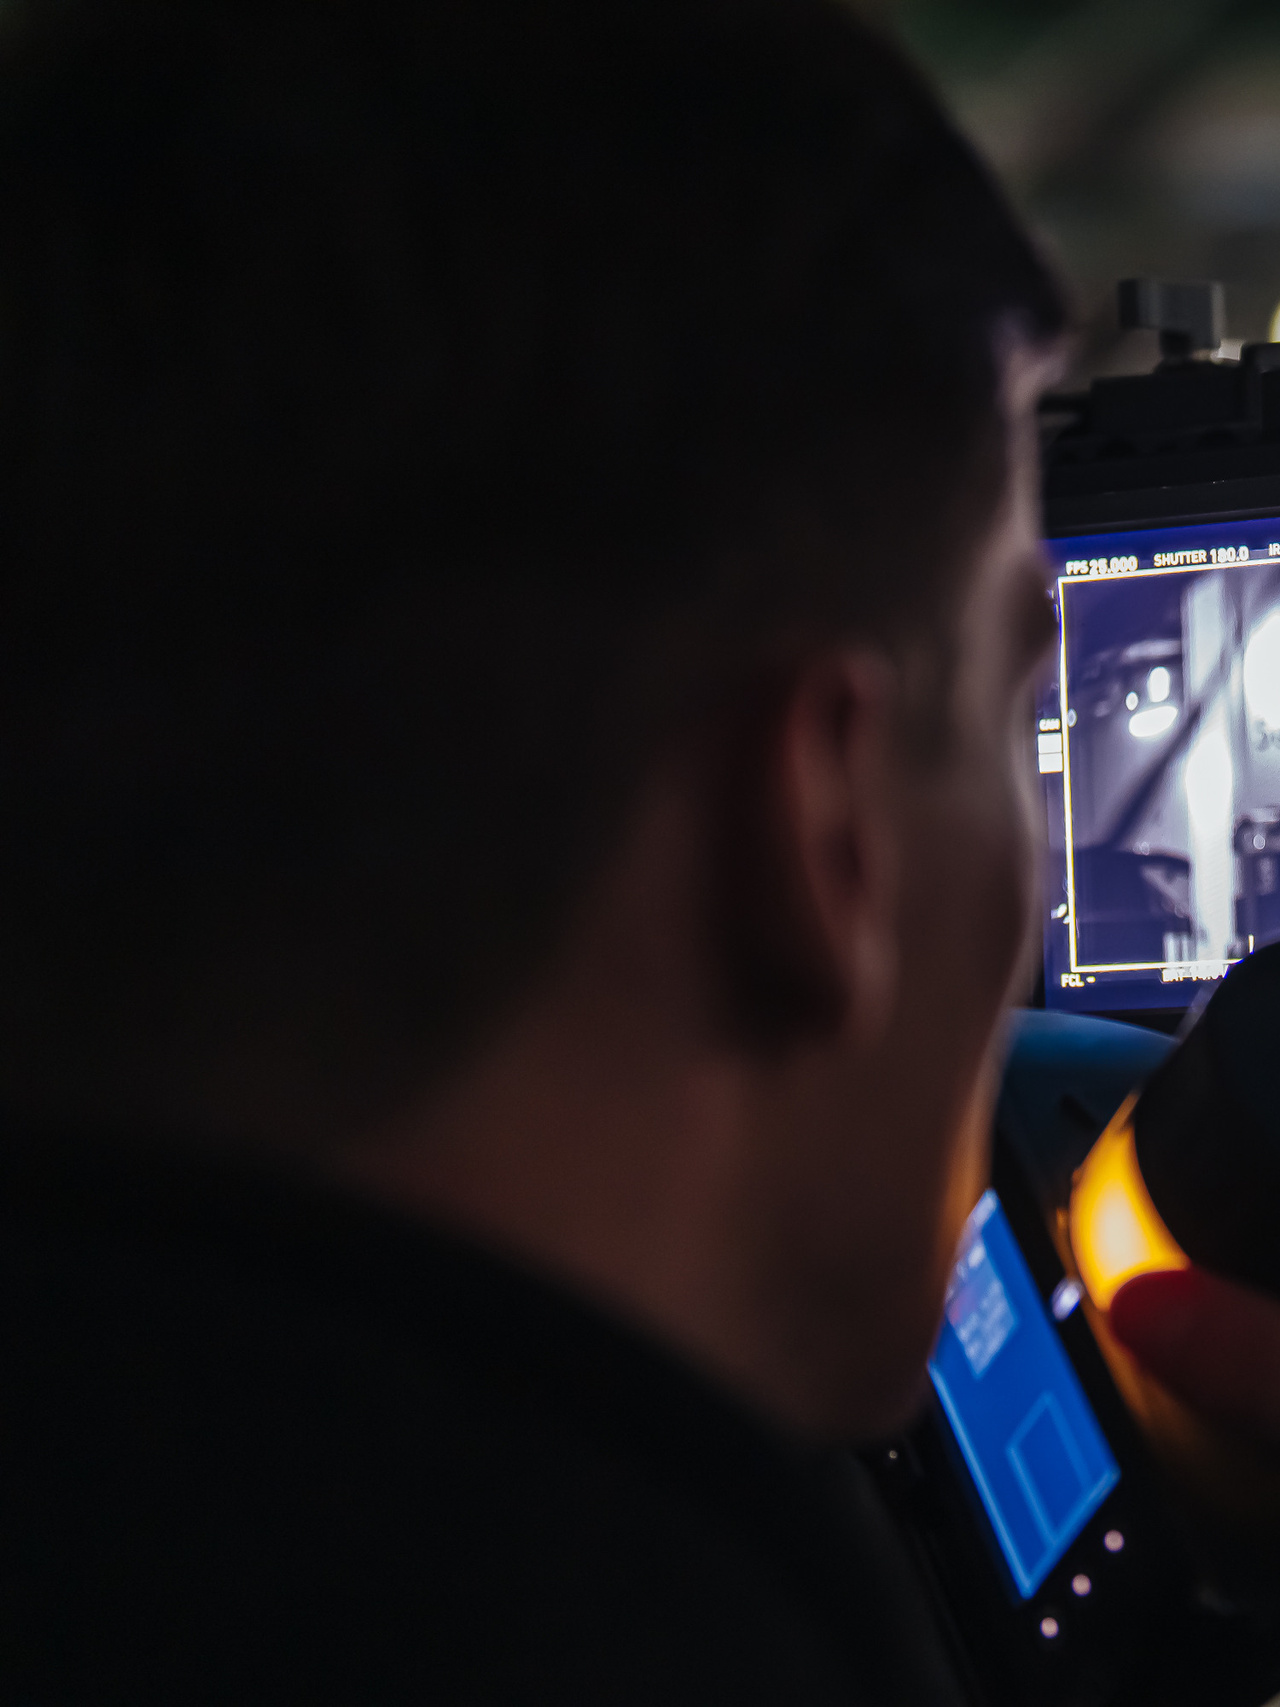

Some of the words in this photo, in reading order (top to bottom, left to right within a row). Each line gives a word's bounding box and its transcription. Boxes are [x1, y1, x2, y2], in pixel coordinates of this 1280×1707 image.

[1065, 560, 1089, 575] FPS
[1153, 549, 1207, 567] SHUTTER
[1209, 545, 1249, 564] 180.0
[1061, 974, 1085, 987] FCL
